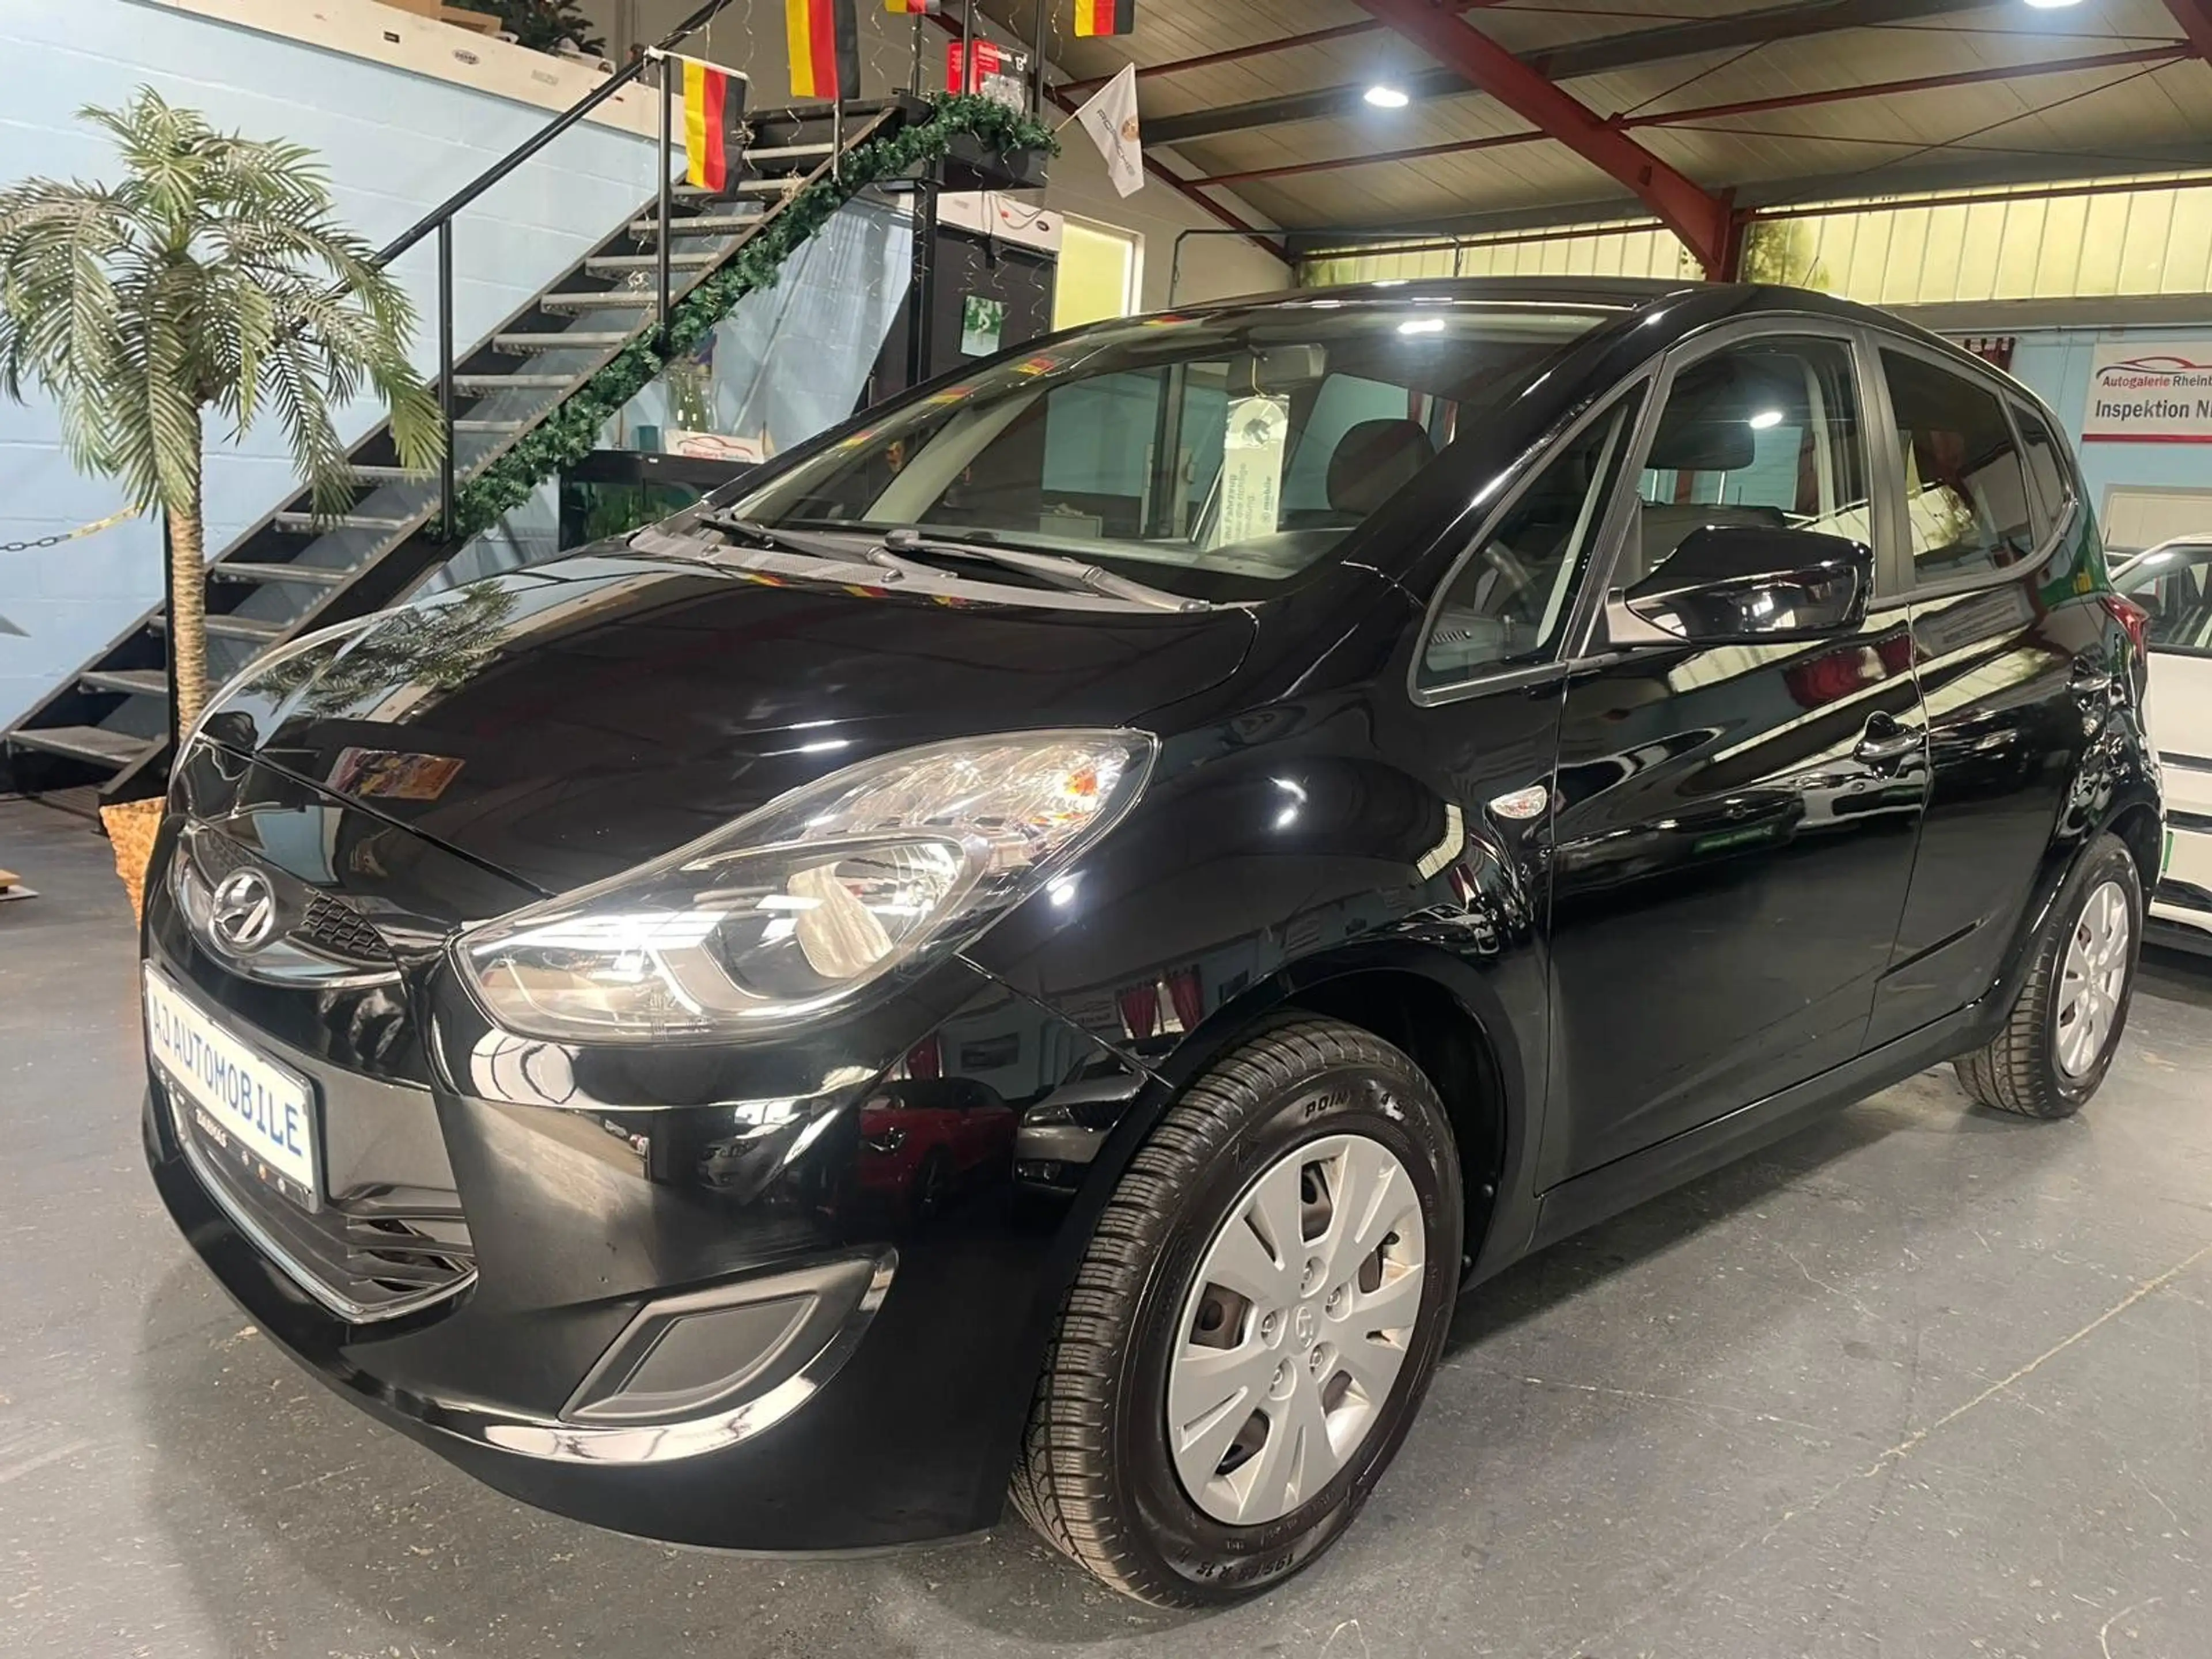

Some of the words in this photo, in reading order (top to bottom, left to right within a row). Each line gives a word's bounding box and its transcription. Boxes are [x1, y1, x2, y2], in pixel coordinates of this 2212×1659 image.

[2103, 376, 2171, 389] Autogalerie
[2095, 399, 2190, 421] Inspektion
[2195, 399, 2212, 418] N
[153, 995, 171, 1050] AJ
[173, 1014, 303, 1157] AUTOMOBILE
